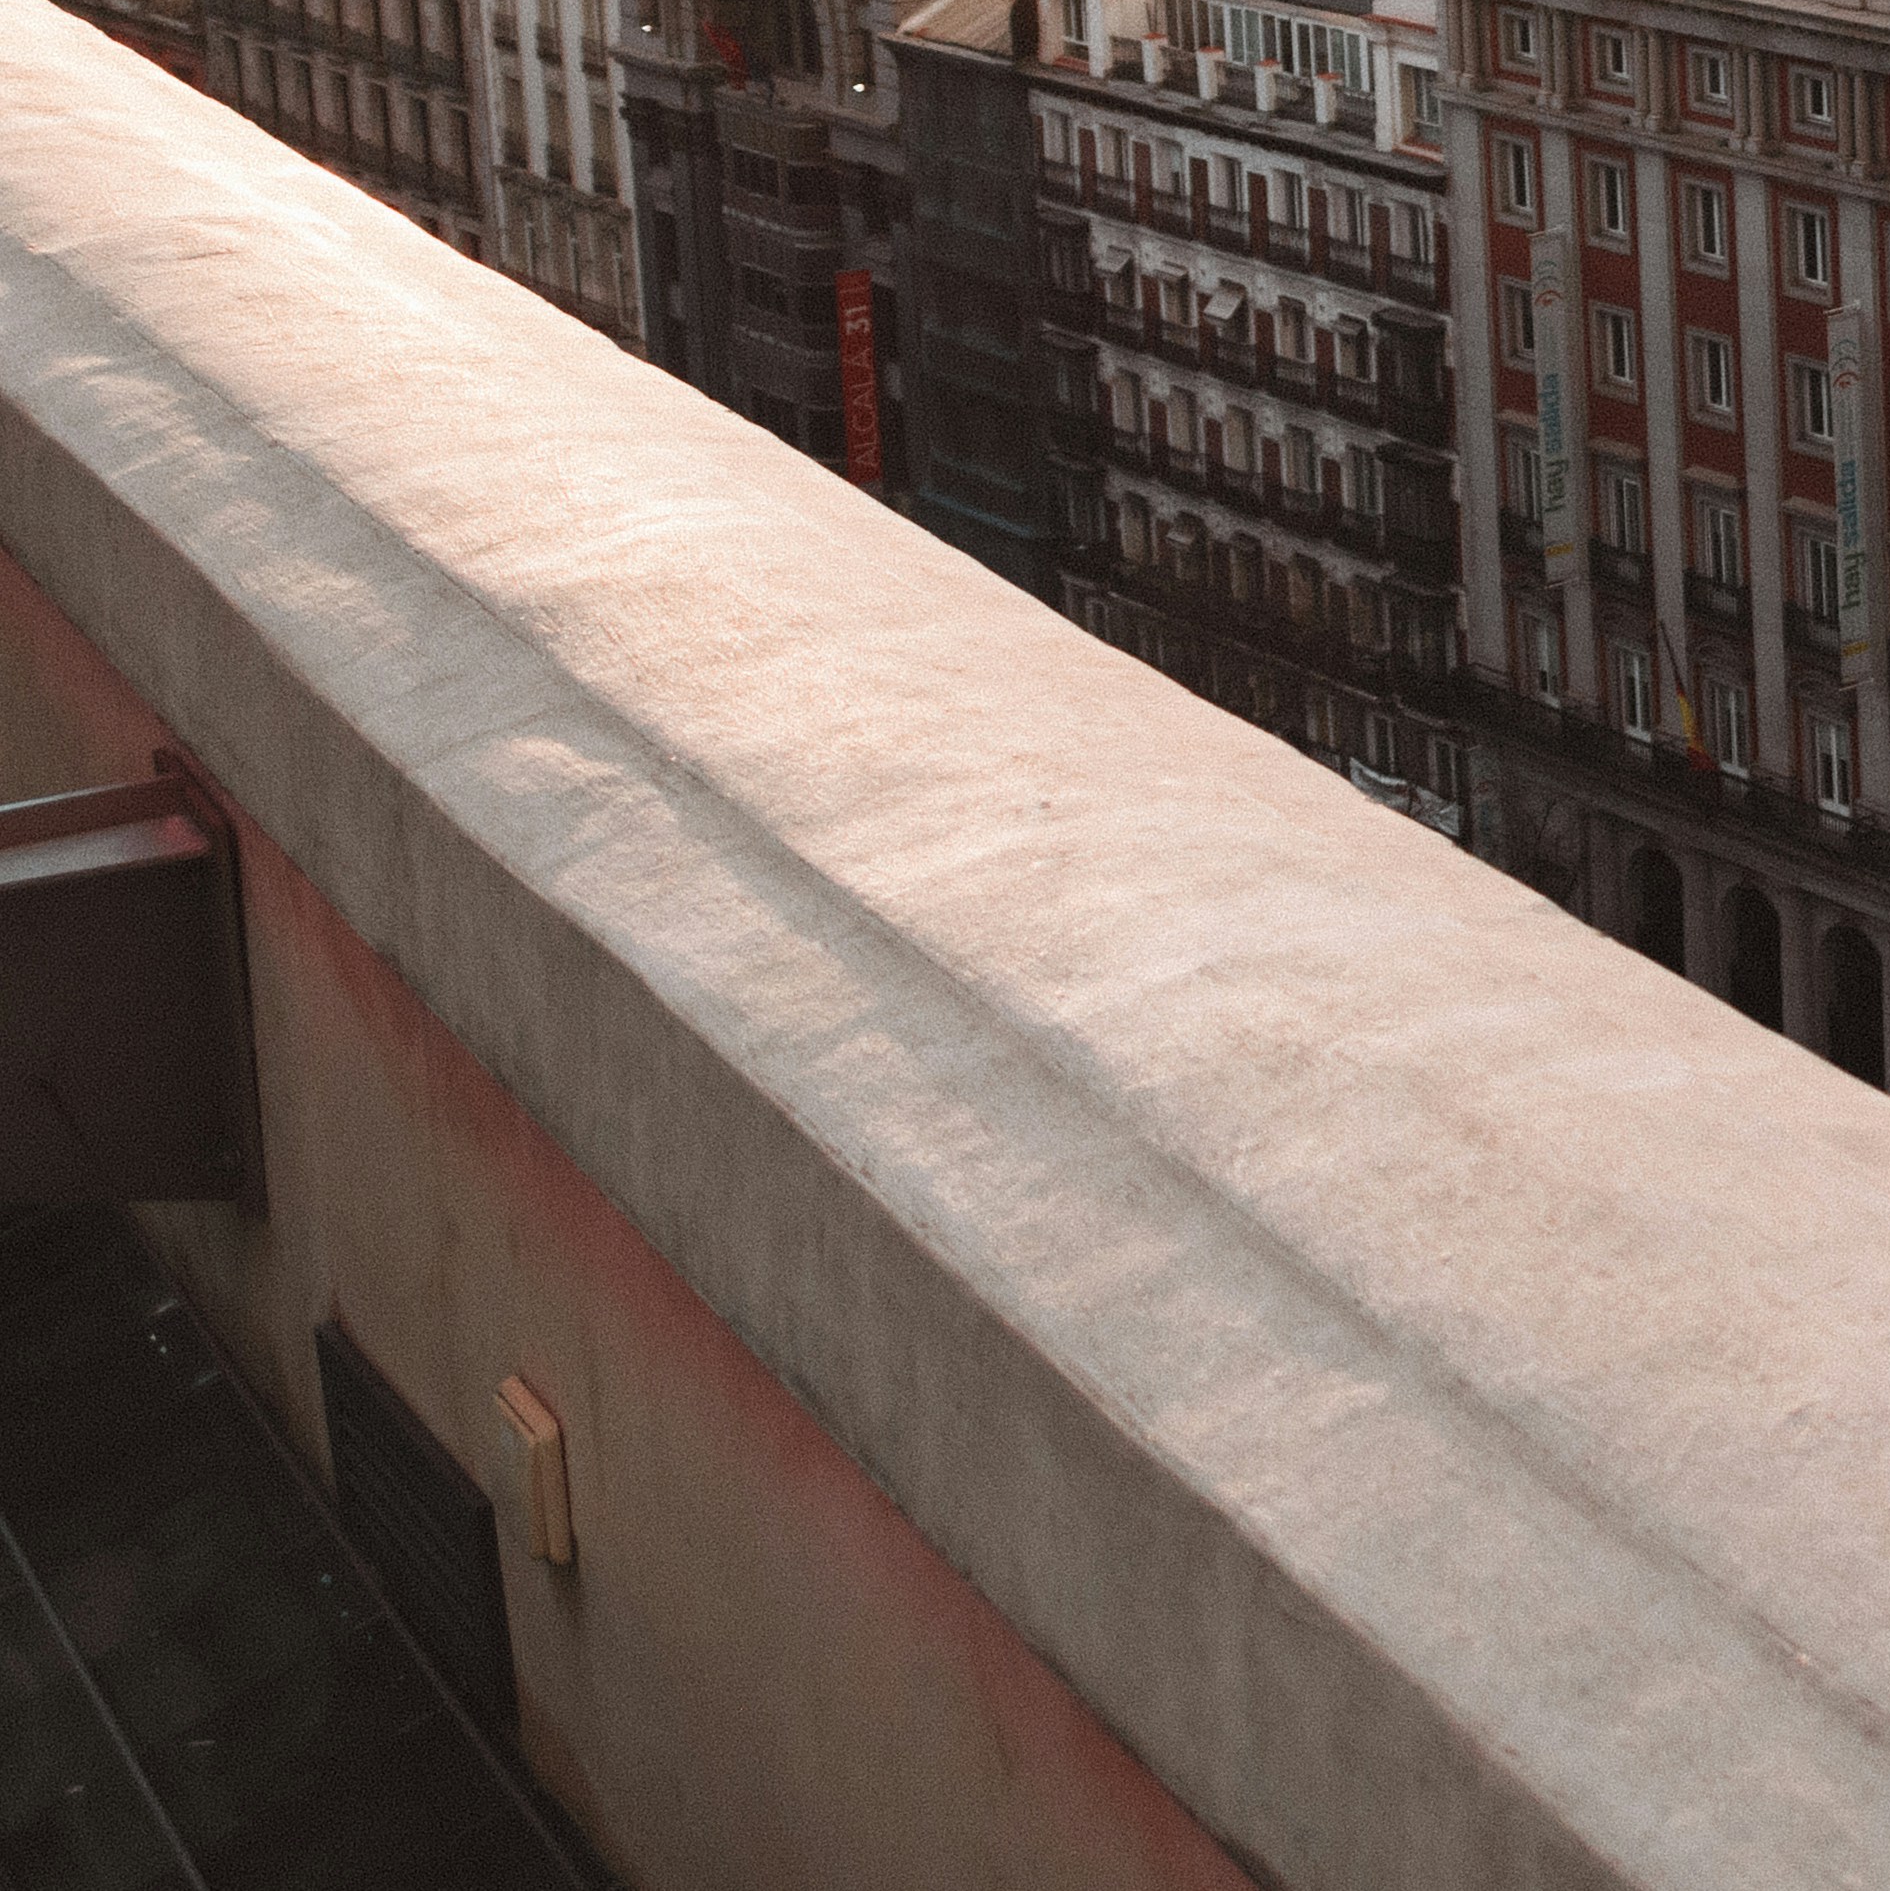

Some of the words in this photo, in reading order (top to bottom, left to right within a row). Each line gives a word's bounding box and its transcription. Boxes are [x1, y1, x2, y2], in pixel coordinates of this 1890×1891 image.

[844, 304, 870, 335] 31
[1539, 373, 1562, 452] salida
[1543, 457, 1569, 514] hay
[1838, 459, 1859, 548] salida
[1841, 551, 1865, 610] hay
